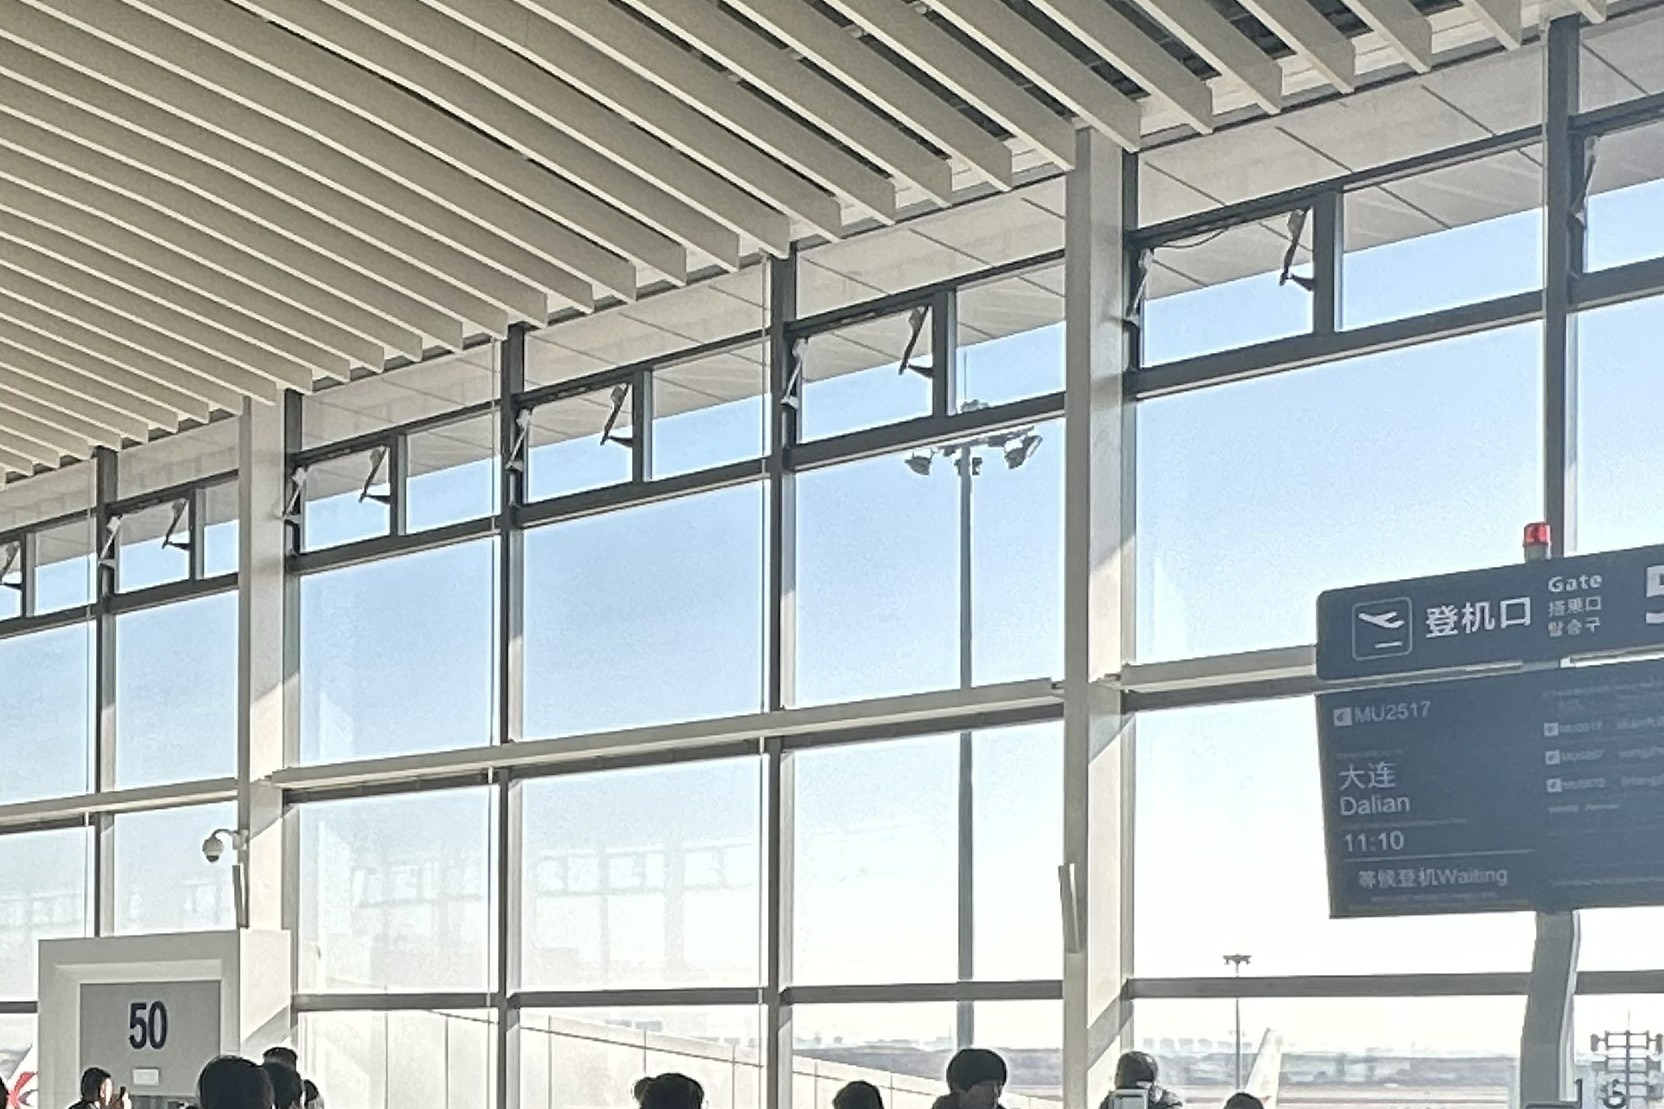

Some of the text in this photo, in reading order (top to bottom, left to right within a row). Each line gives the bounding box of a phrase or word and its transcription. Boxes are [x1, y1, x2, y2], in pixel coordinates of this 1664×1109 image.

[1548, 574, 1602, 592] Gate
[1426, 597, 1531, 639] 登机口
[1354, 701, 1431, 724] MU2517
[1339, 761, 1397, 790] 大连
[1339, 794, 1411, 816] Dalian
[1344, 831, 1405, 852] 11:10
[128, 1000, 168, 1050] 50
